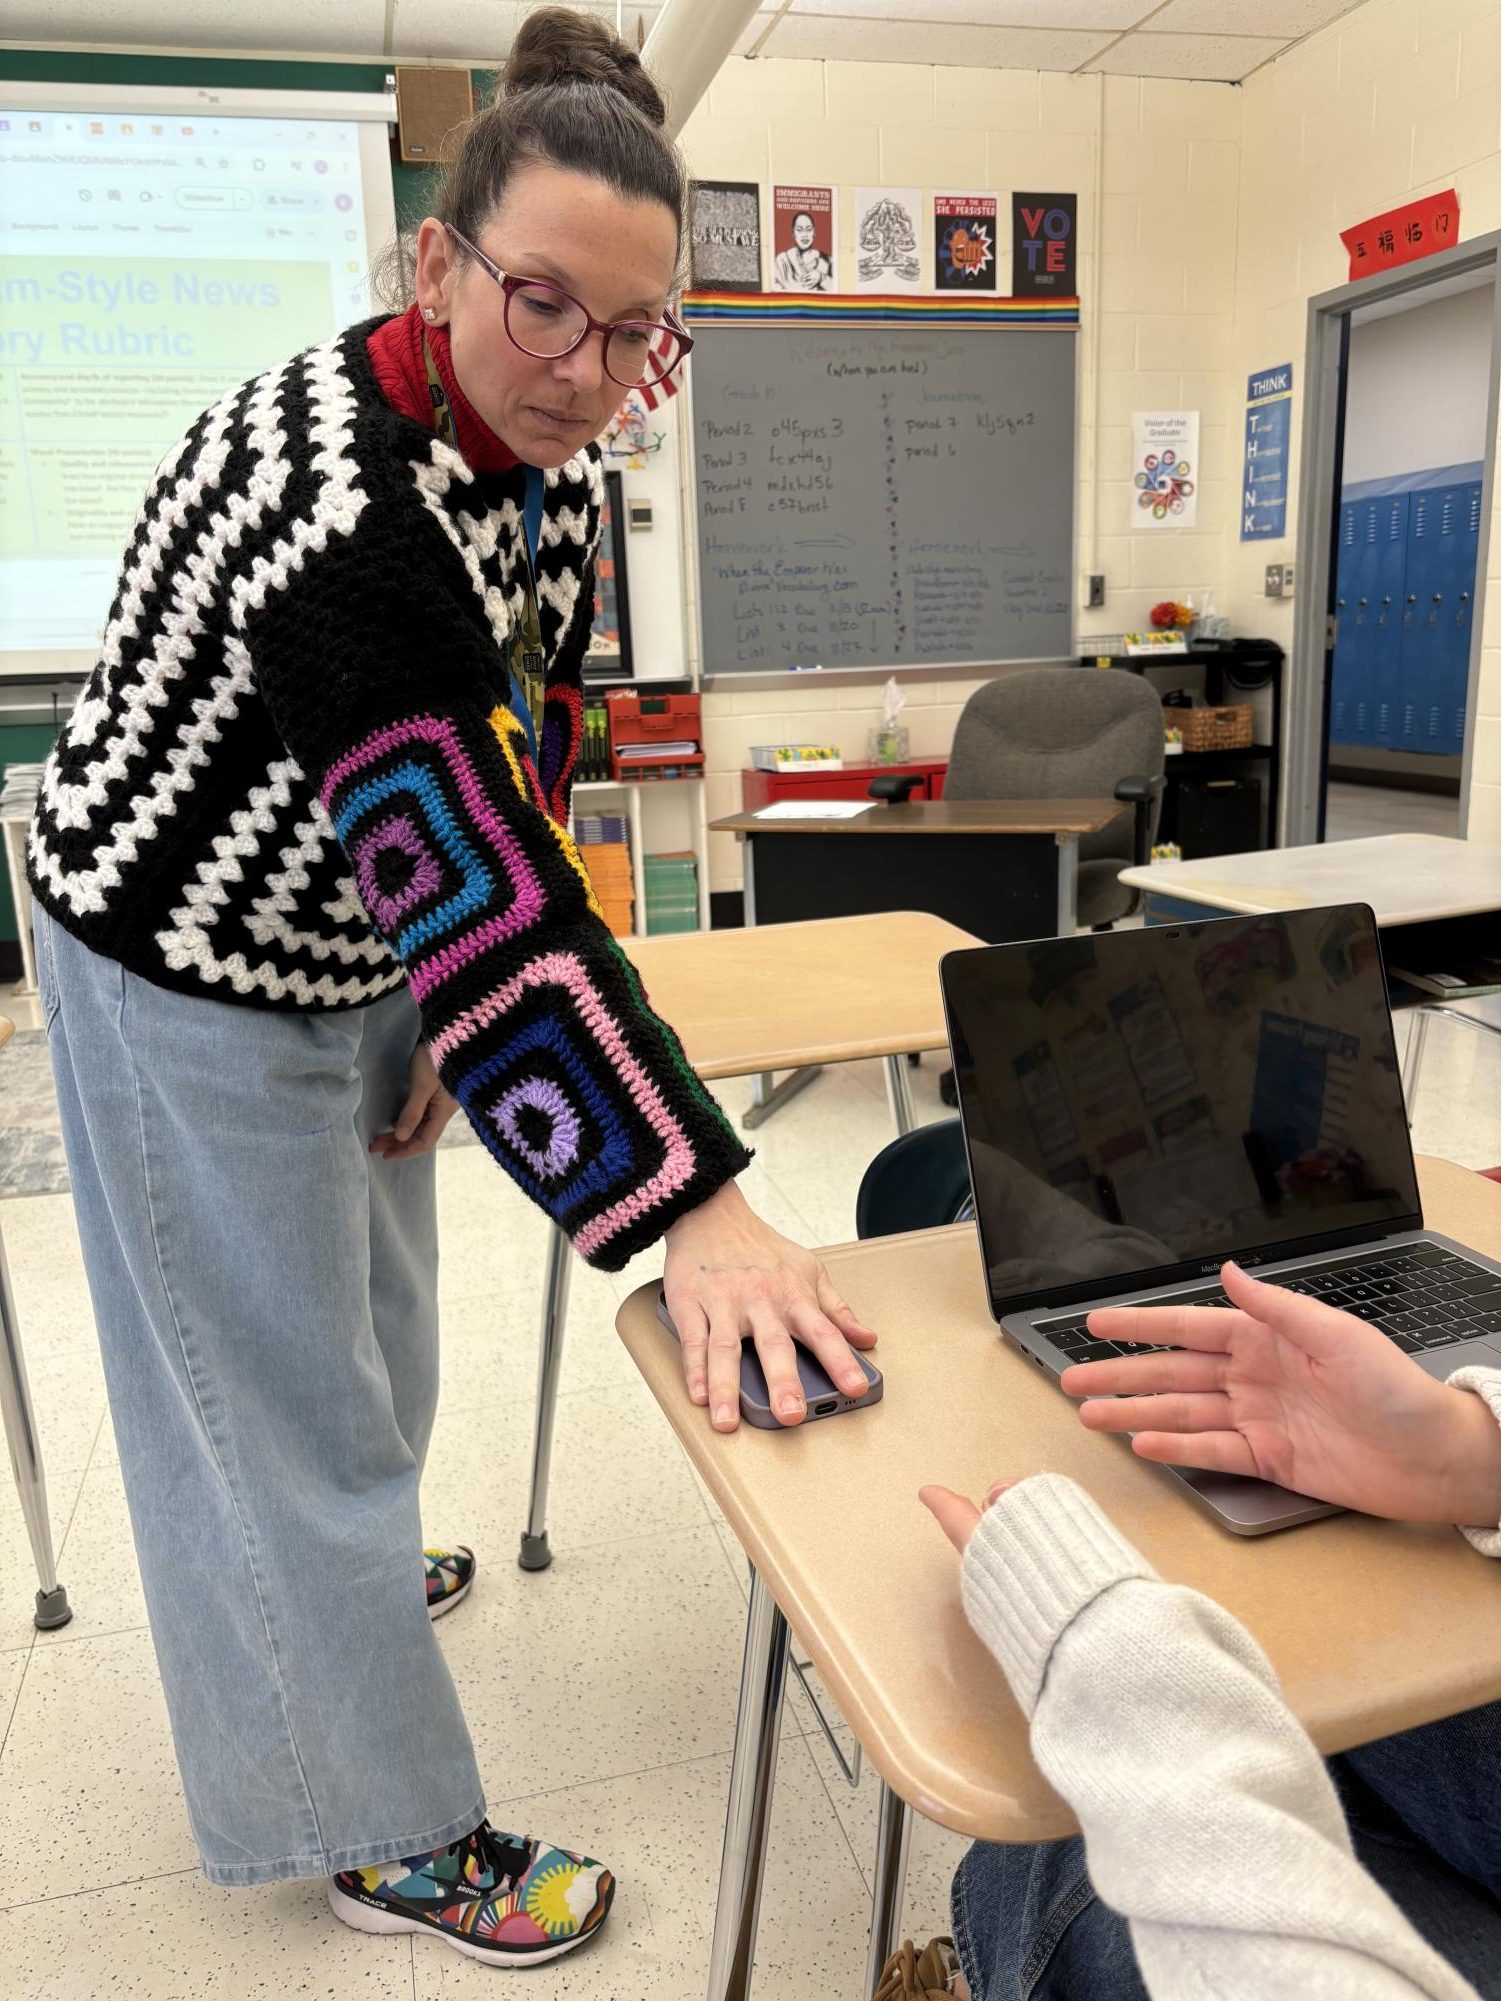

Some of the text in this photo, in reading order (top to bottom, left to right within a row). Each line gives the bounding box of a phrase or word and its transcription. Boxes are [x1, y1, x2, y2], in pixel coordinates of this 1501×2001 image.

[936, 205, 995, 217] SHE PERSISTED
[1356, 213, 1449, 258] 五福临门
[172, 271, 281, 307] News
[0, 321, 197, 364] ry Rubric
[1252, 374, 1288, 397] THINK
[702, 419, 741, 440] Period
[743, 423, 754, 436] 2
[738, 452, 748, 467] 3
[702, 478, 741, 494] Period
[743, 477, 752, 490] 4
[1201, 1263, 1221, 1272] MacBo
[359, 1893, 388, 1909] TRACE
